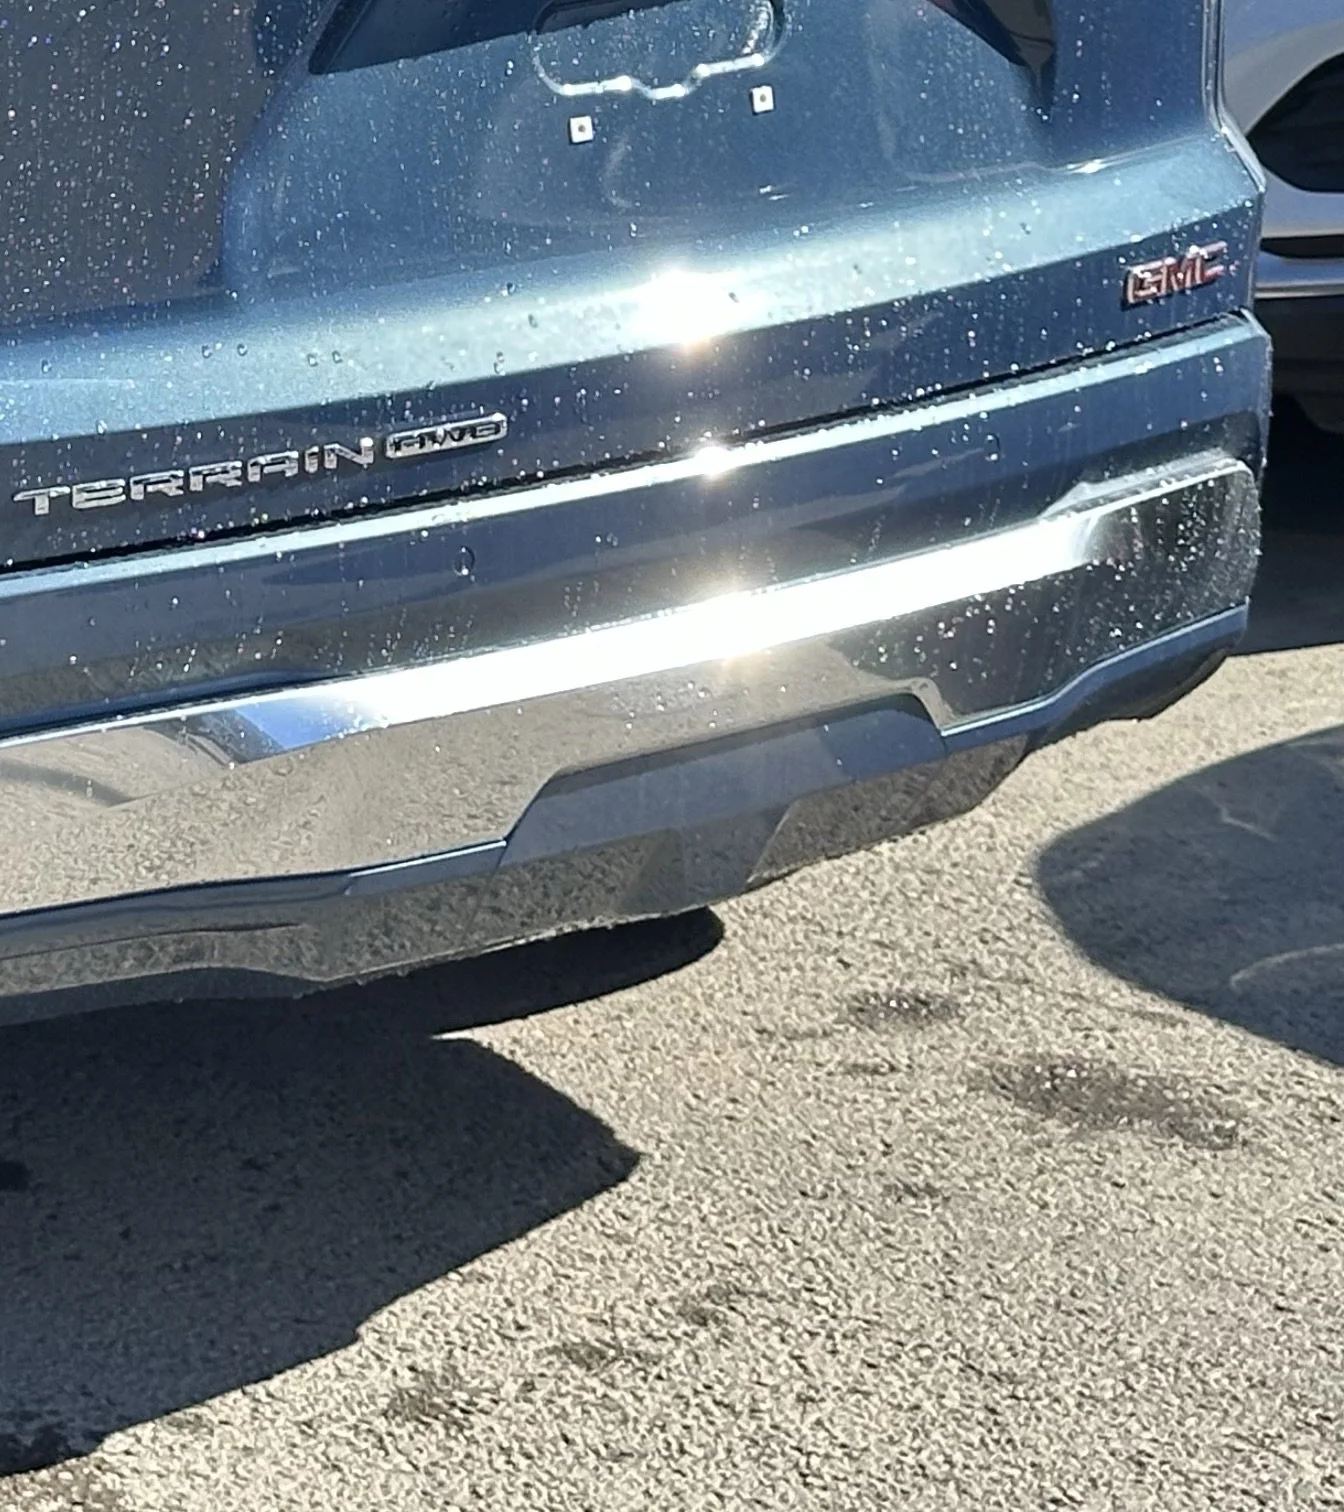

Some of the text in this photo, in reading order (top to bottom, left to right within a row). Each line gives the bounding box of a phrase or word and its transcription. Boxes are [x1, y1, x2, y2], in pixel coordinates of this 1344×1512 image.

[1124, 239, 1229, 305] GMC
[12, 419, 502, 517] TERRAIN AWD
